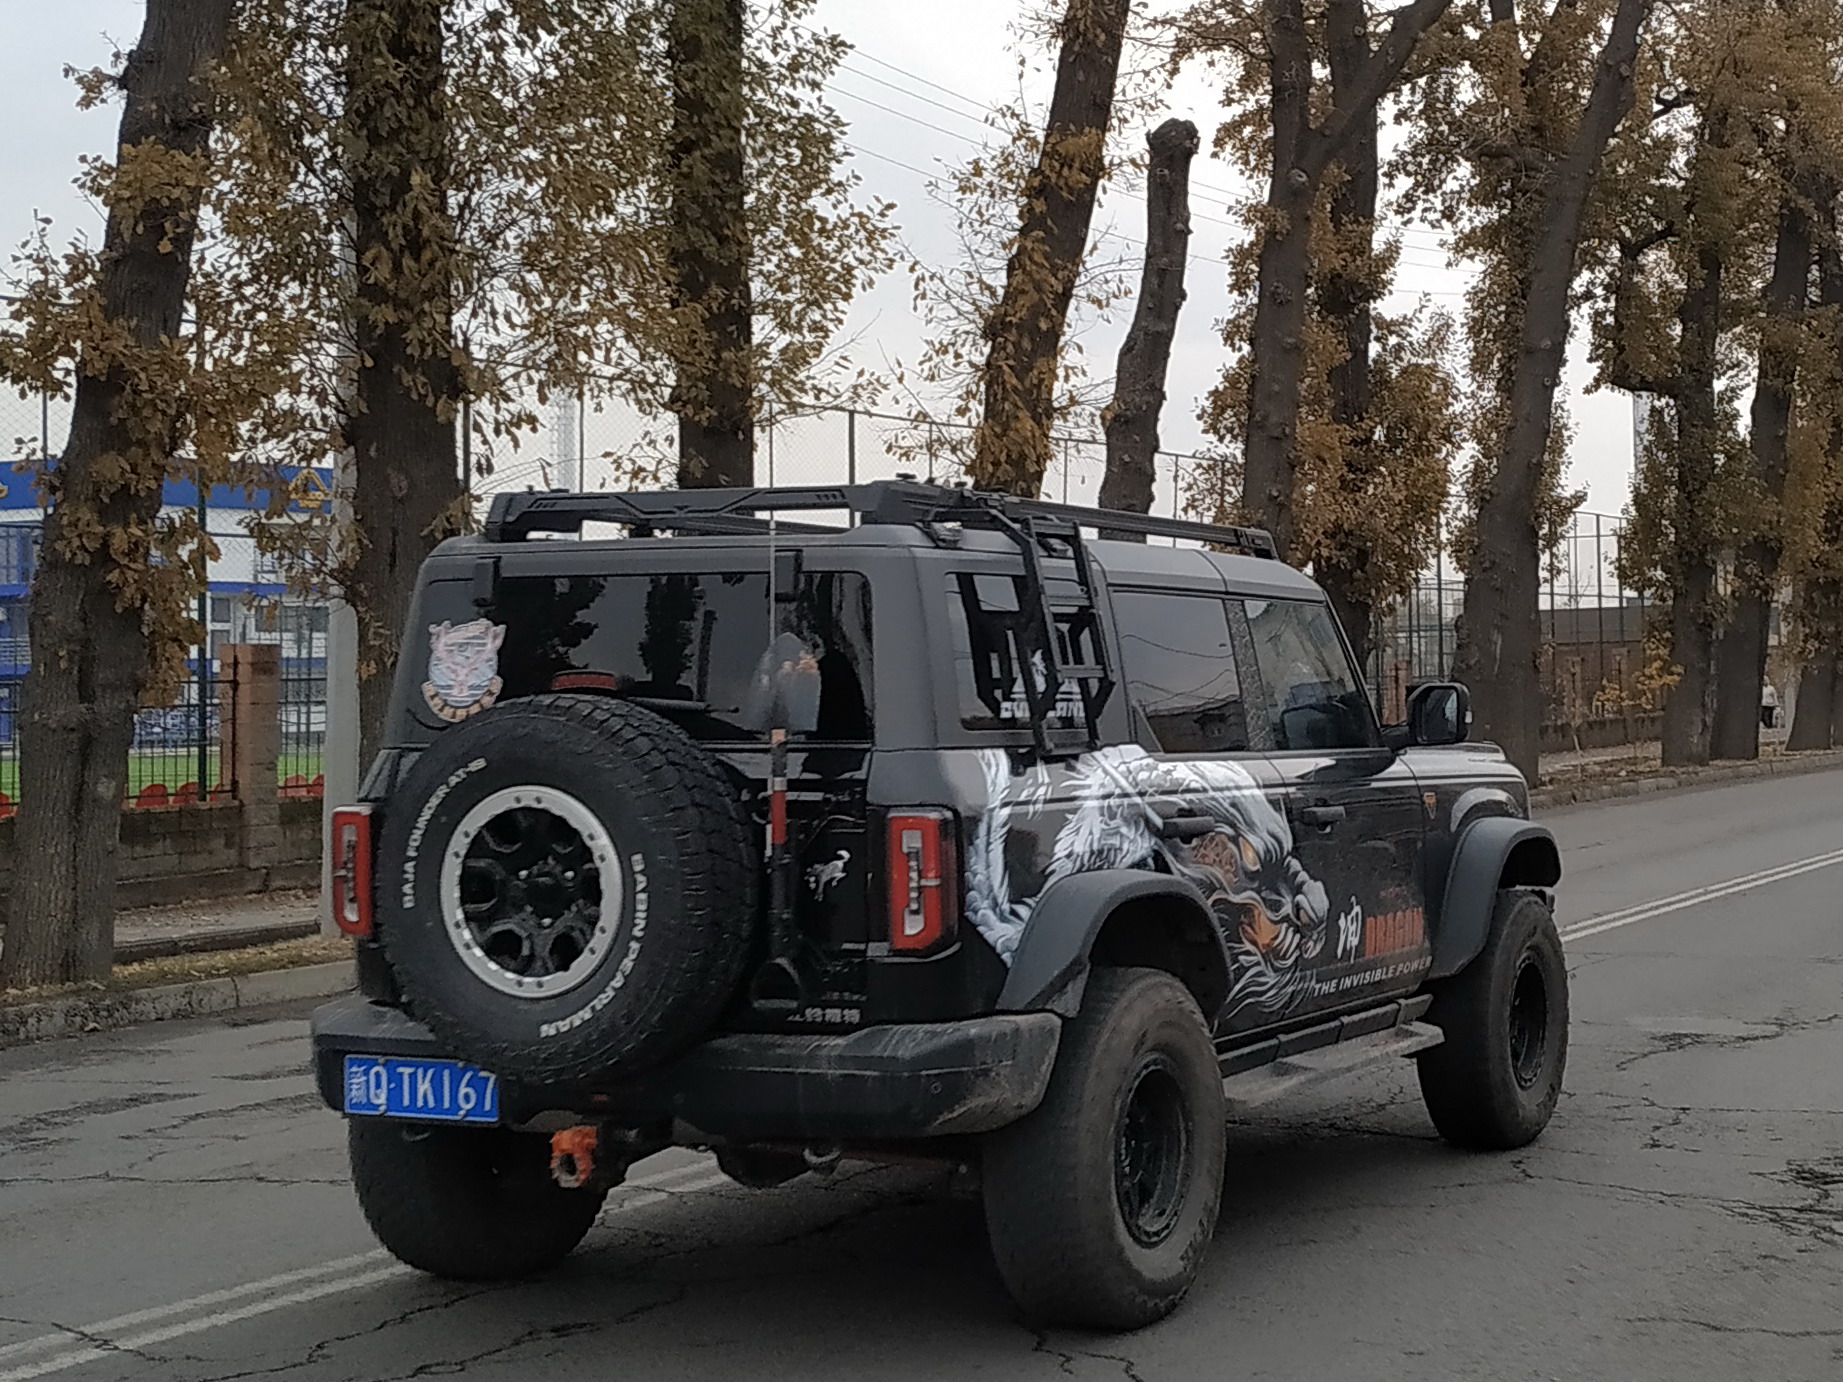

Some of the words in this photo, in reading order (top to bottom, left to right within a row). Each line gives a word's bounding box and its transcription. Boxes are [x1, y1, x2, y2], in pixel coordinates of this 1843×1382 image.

[402, 861, 416, 909] BAJA
[630, 853, 648, 938] BABIN
[1313, 978, 1338, 998] THE
[1339, 963, 1396, 991] INVISIBLE
[1395, 955, 1433, 976] POWER
